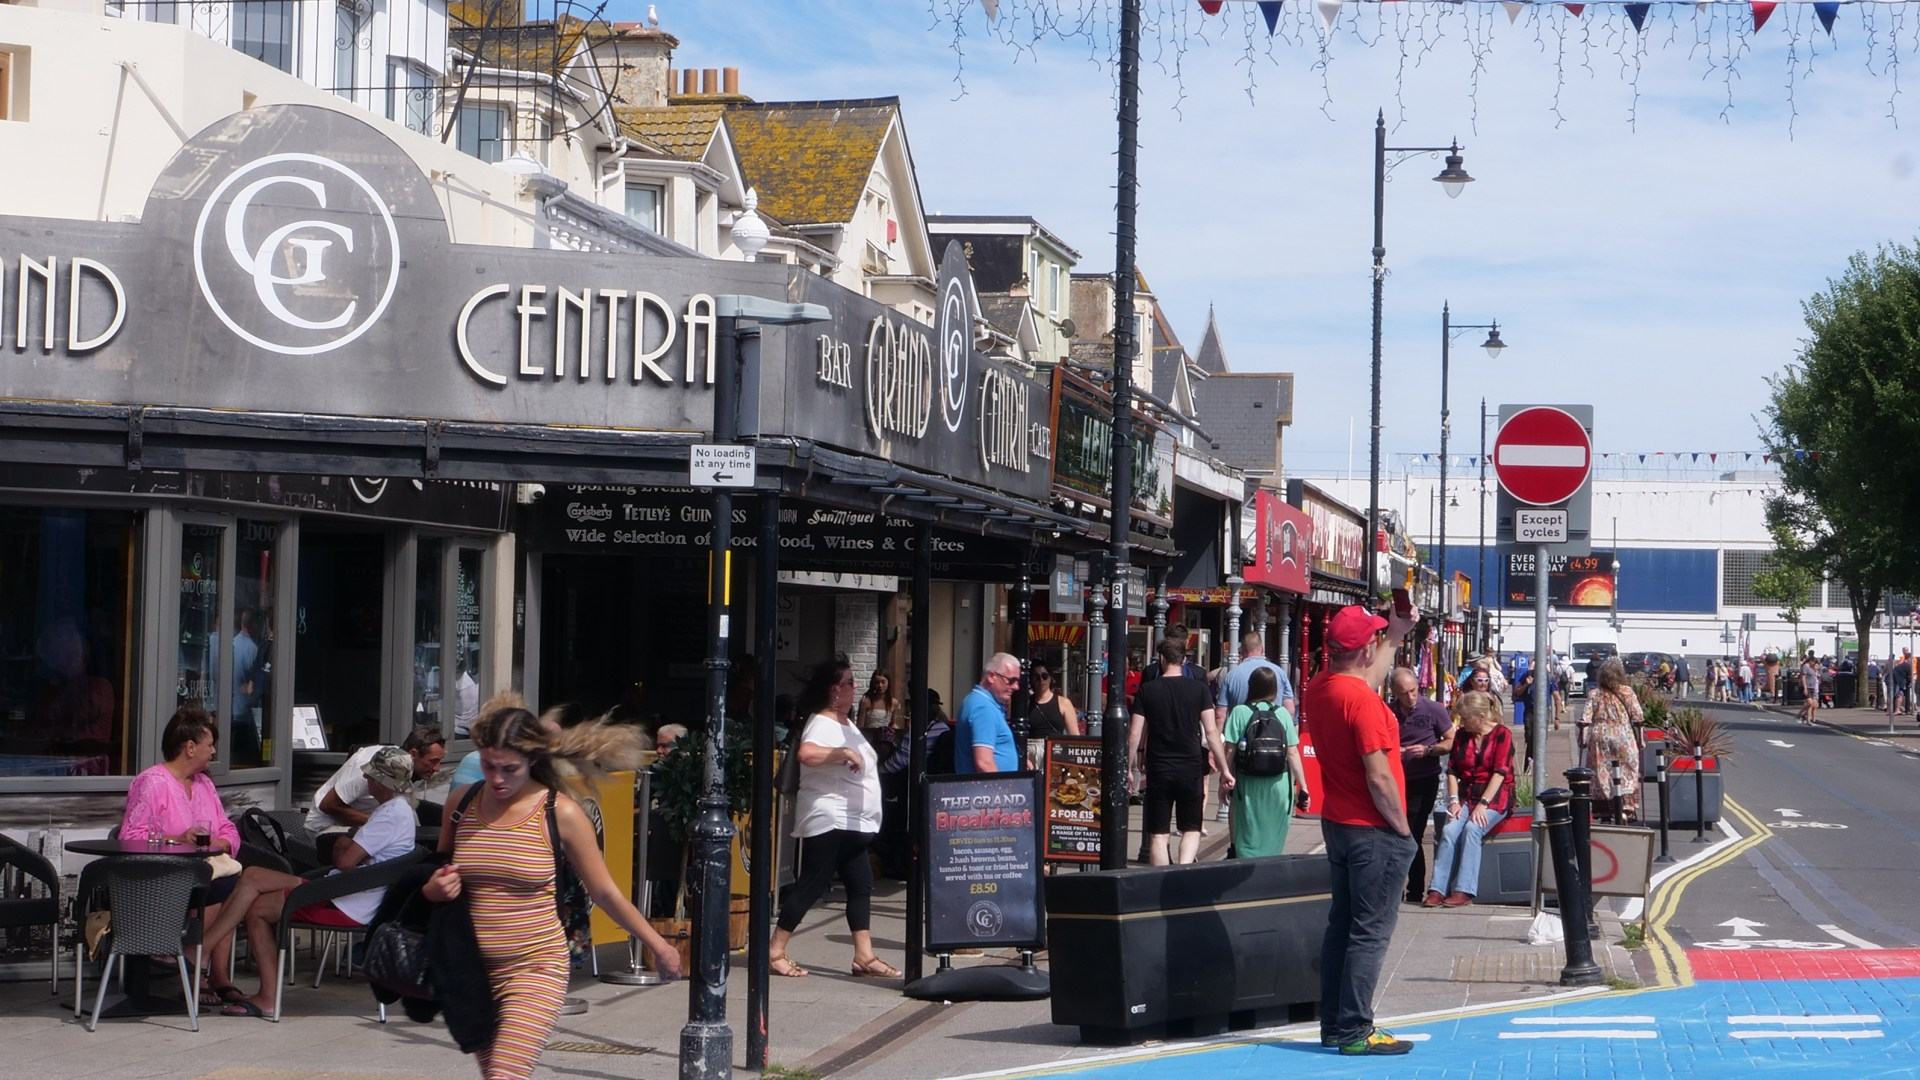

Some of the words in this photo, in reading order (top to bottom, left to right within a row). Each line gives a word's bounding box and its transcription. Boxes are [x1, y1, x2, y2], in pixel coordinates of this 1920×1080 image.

[0, 254, 127, 352] ND
[456, 283, 715, 387] CENTRA
[820, 333, 853, 390] BAR
[867, 314, 932, 441] GRAND
[980, 367, 1030, 473] CENTRAL
[696, 449, 711, 458] No
[713, 449, 751, 460] loading
[694, 460, 705, 468] at
[707, 461, 726, 470] any
[729, 460, 751, 469] time
[566, 502, 613, 521] Carlsberg
[680, 505, 747, 522] GUINSS
[1521, 514, 1563, 526] Except
[1522, 527, 1560, 539] cycles
[565, 528, 607, 543] Wide
[613, 530, 687, 545] Selection
[694, 532, 711, 546] of
[778, 535, 815, 550] ood,
[824, 535, 874, 550] Wines
[881, 537, 896, 550] &
[904, 537, 966, 552] Cfees
[1510, 554, 1536, 563] EVER
[1510, 563, 1536, 572] EVER
[1113, 584, 1121, 595] 8
[1113, 597, 1121, 607] A
[1068, 748, 1102, 757] HENRY'
[1076, 756, 1096, 764] BAR
[940, 796, 970, 809] THE
[972, 794, 1026, 807] GRAND
[1050, 809, 1057, 818] 2
[1058, 810, 1078, 818] FOR
[1079, 810, 1094, 819] £15
[936, 808, 1033, 832] Breakfast
[954, 856, 970, 864] hash
[1009, 862, 1029, 870] bread
[970, 882, 998, 894] £8.50
